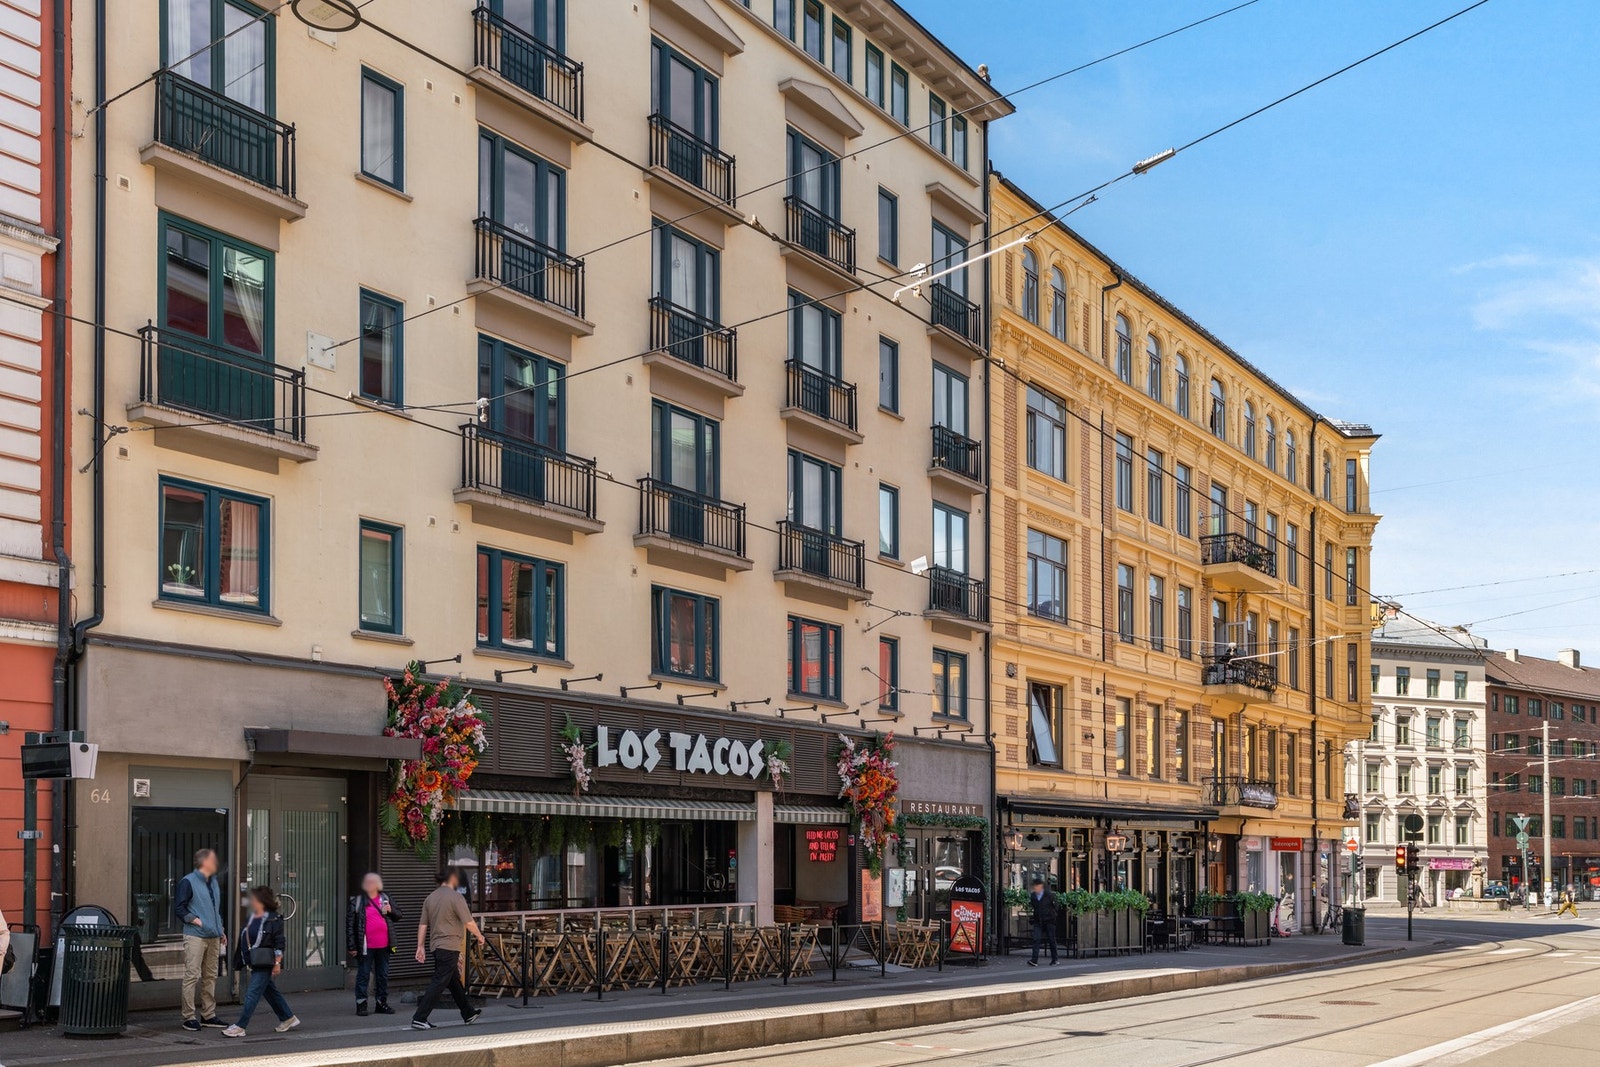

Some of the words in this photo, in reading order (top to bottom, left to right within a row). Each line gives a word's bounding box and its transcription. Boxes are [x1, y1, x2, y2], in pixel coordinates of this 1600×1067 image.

[598, 725, 662, 773] LOS
[670, 732, 765, 780] TACOS
[90, 788, 111, 804] 64
[910, 802, 977, 815] RESTAURANT
[954, 908, 981, 919] CRUNCH
